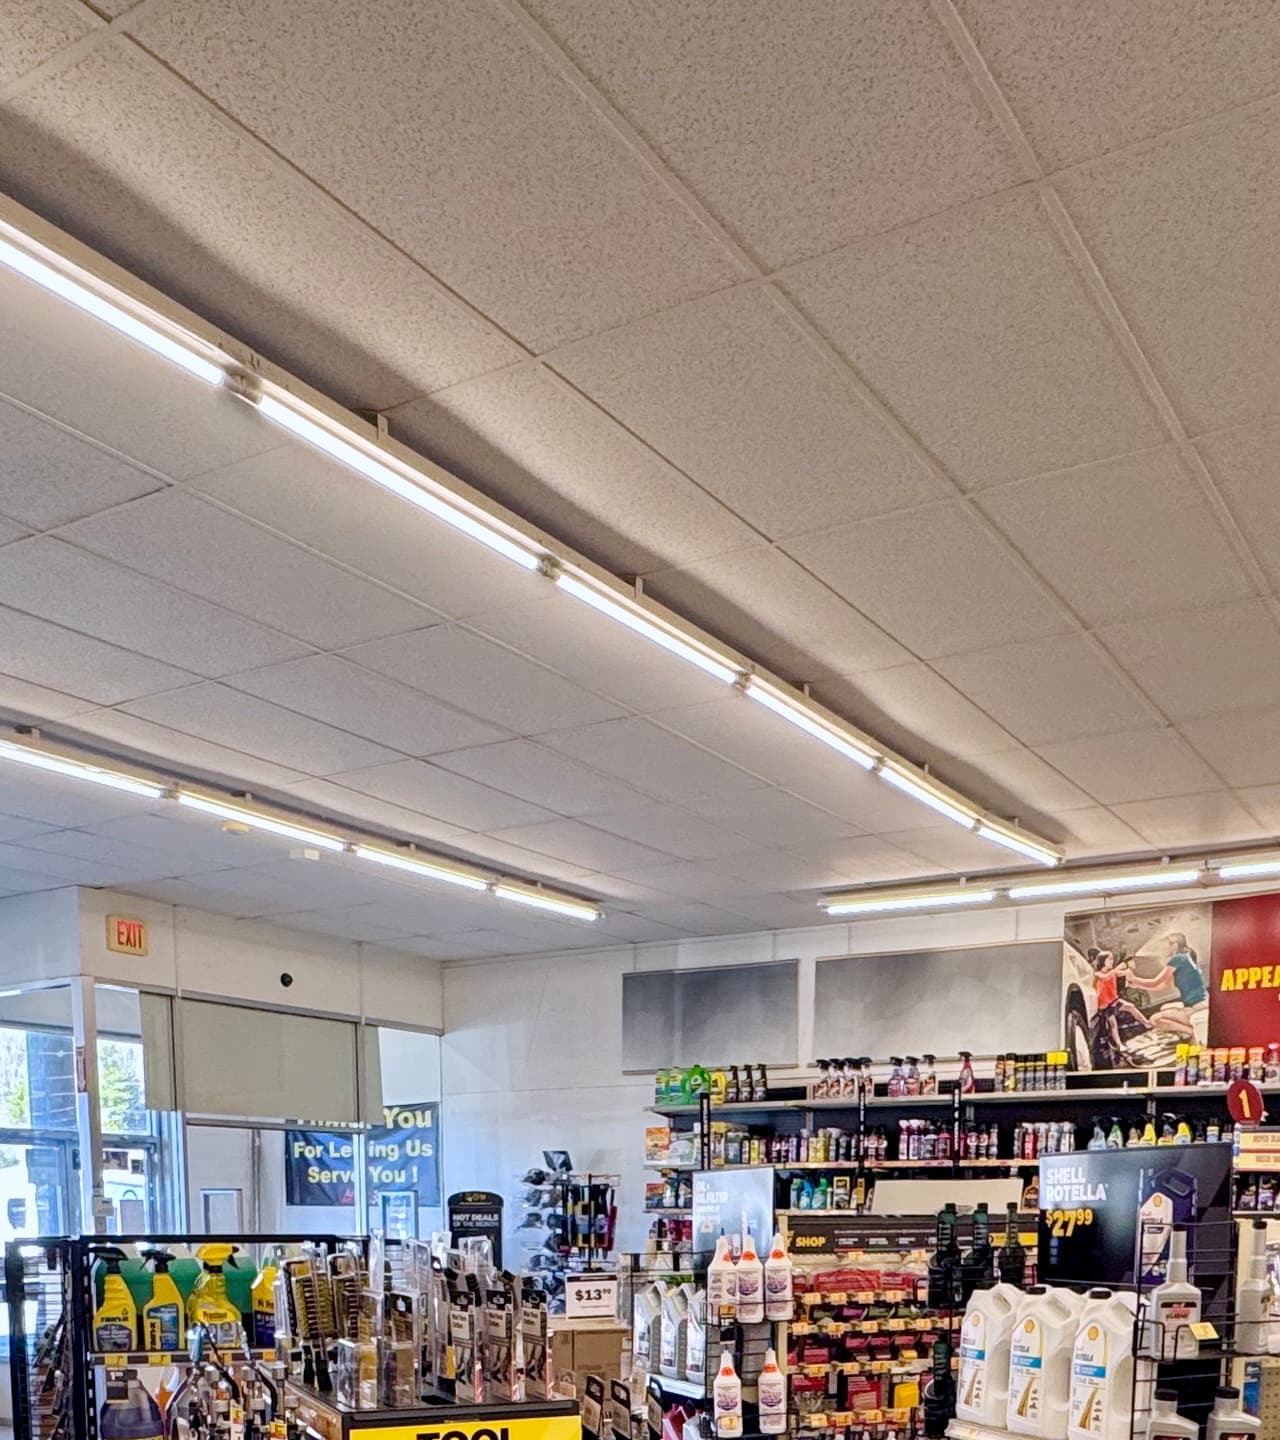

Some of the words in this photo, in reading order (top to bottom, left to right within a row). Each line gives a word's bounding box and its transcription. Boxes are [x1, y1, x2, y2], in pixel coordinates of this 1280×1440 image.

[116, 919, 145, 950] EXIT
[1238, 1089, 1251, 1118] 1
[383, 1107, 433, 1129] You
[294, 1142, 324, 1158] For
[329, 1141, 400, 1160] Leing
[406, 1140, 433, 1157] Us
[369, 1167, 406, 1183] You
[1046, 1168, 1086, 1184] SHELL
[1046, 1183, 1107, 1201] ROTELLA
[471, 1213, 499, 1222] DEALS
[795, 1236, 826, 1248] SHOP
